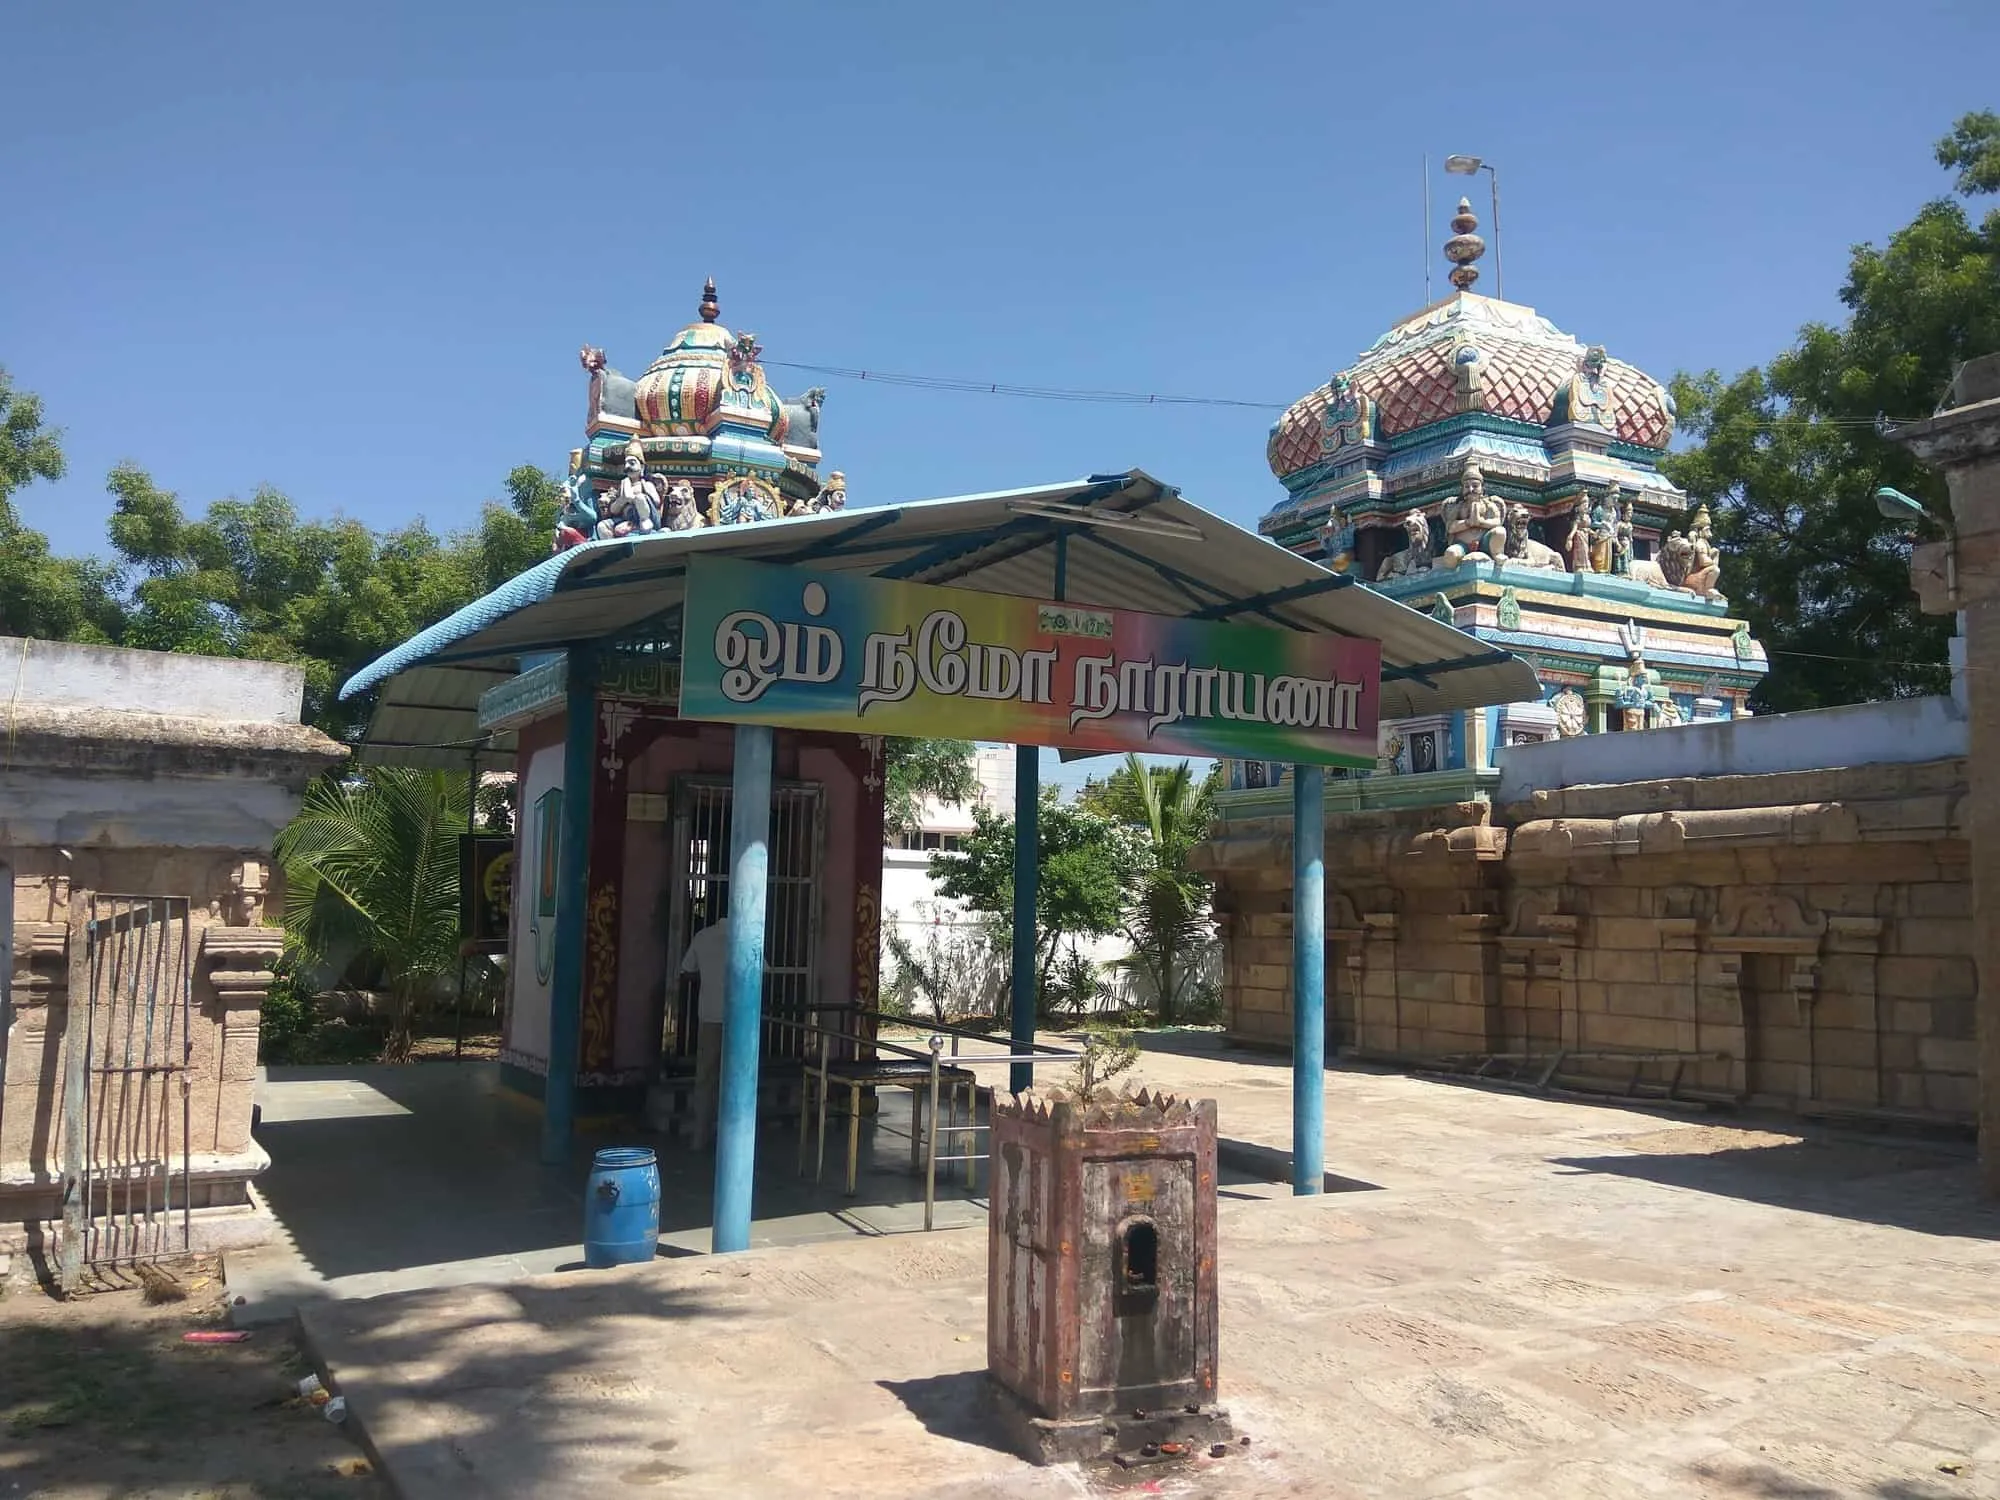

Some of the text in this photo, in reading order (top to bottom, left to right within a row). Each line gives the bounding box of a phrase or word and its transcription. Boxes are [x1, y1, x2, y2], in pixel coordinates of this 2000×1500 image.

[713, 580, 1365, 738] ஓம் நமோ நாராயணா
